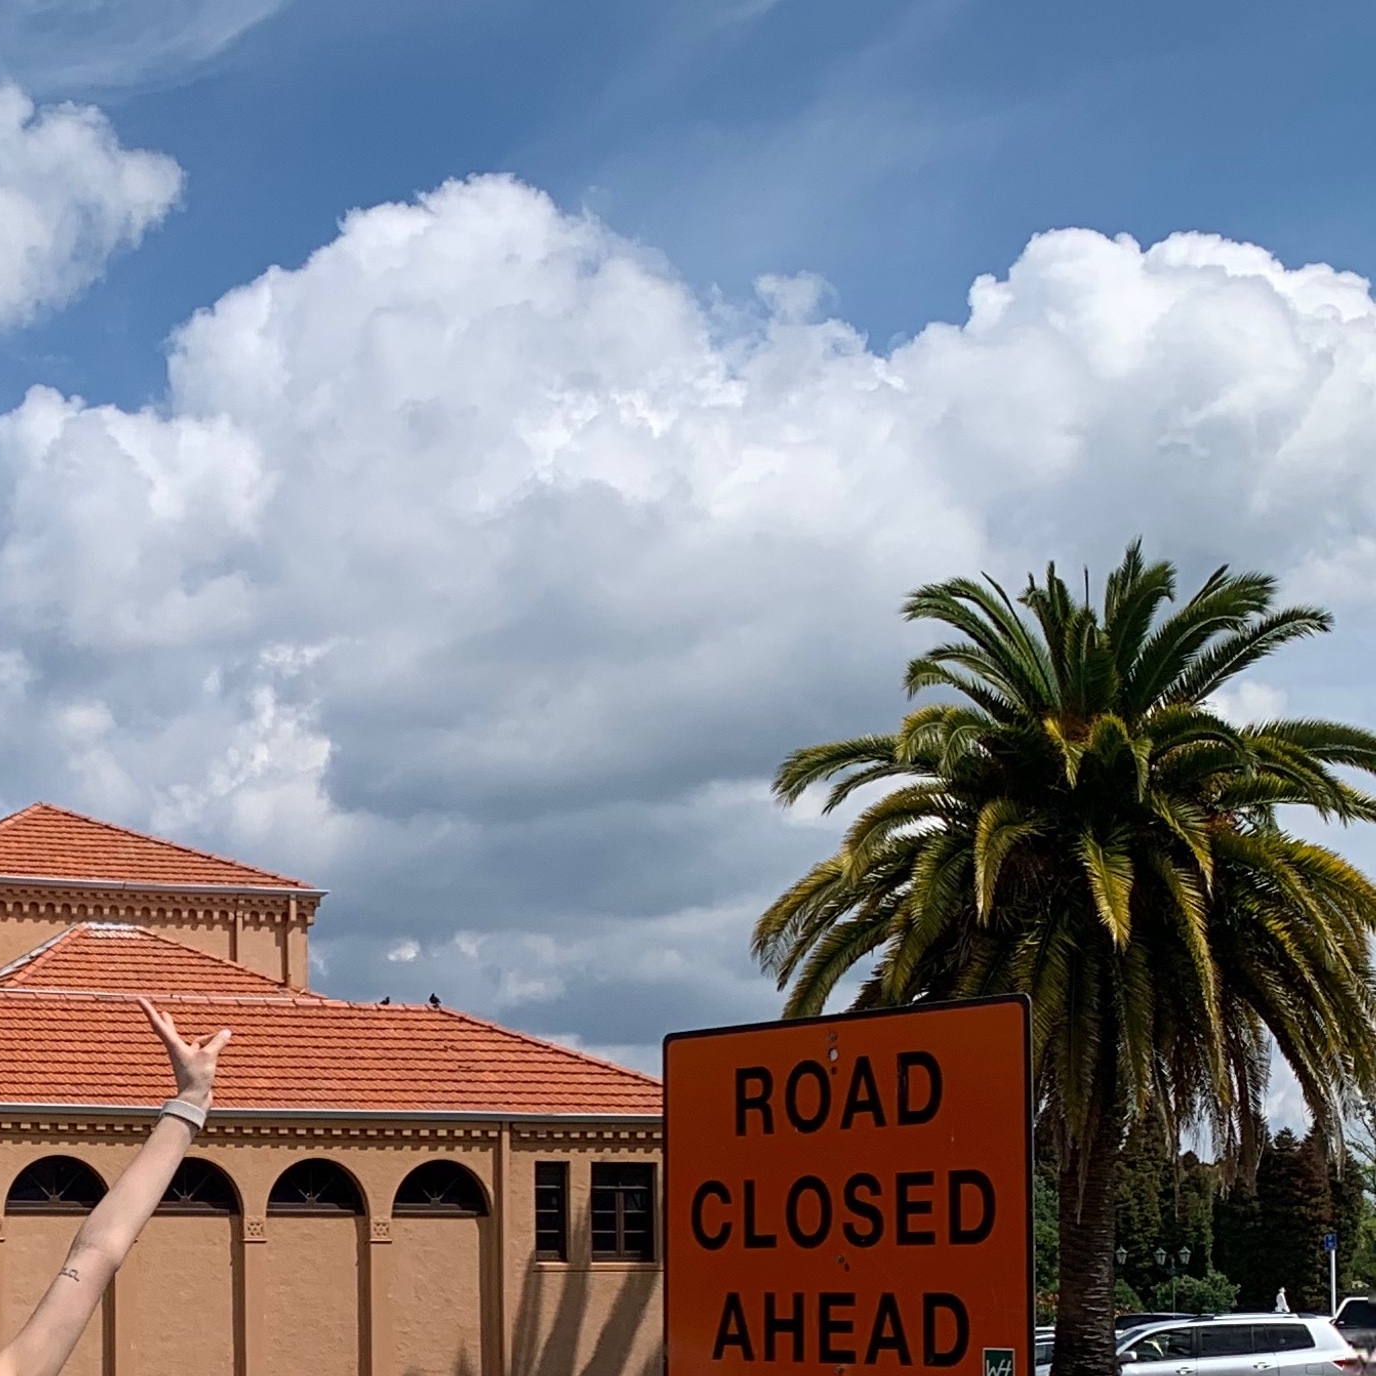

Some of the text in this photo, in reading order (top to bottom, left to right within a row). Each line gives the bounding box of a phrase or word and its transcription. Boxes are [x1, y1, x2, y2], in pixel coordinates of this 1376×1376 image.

[735, 1051, 943, 1136] ROAD
[691, 1169, 996, 1250] CLOSED
[712, 1292, 970, 1367] AHEAD
